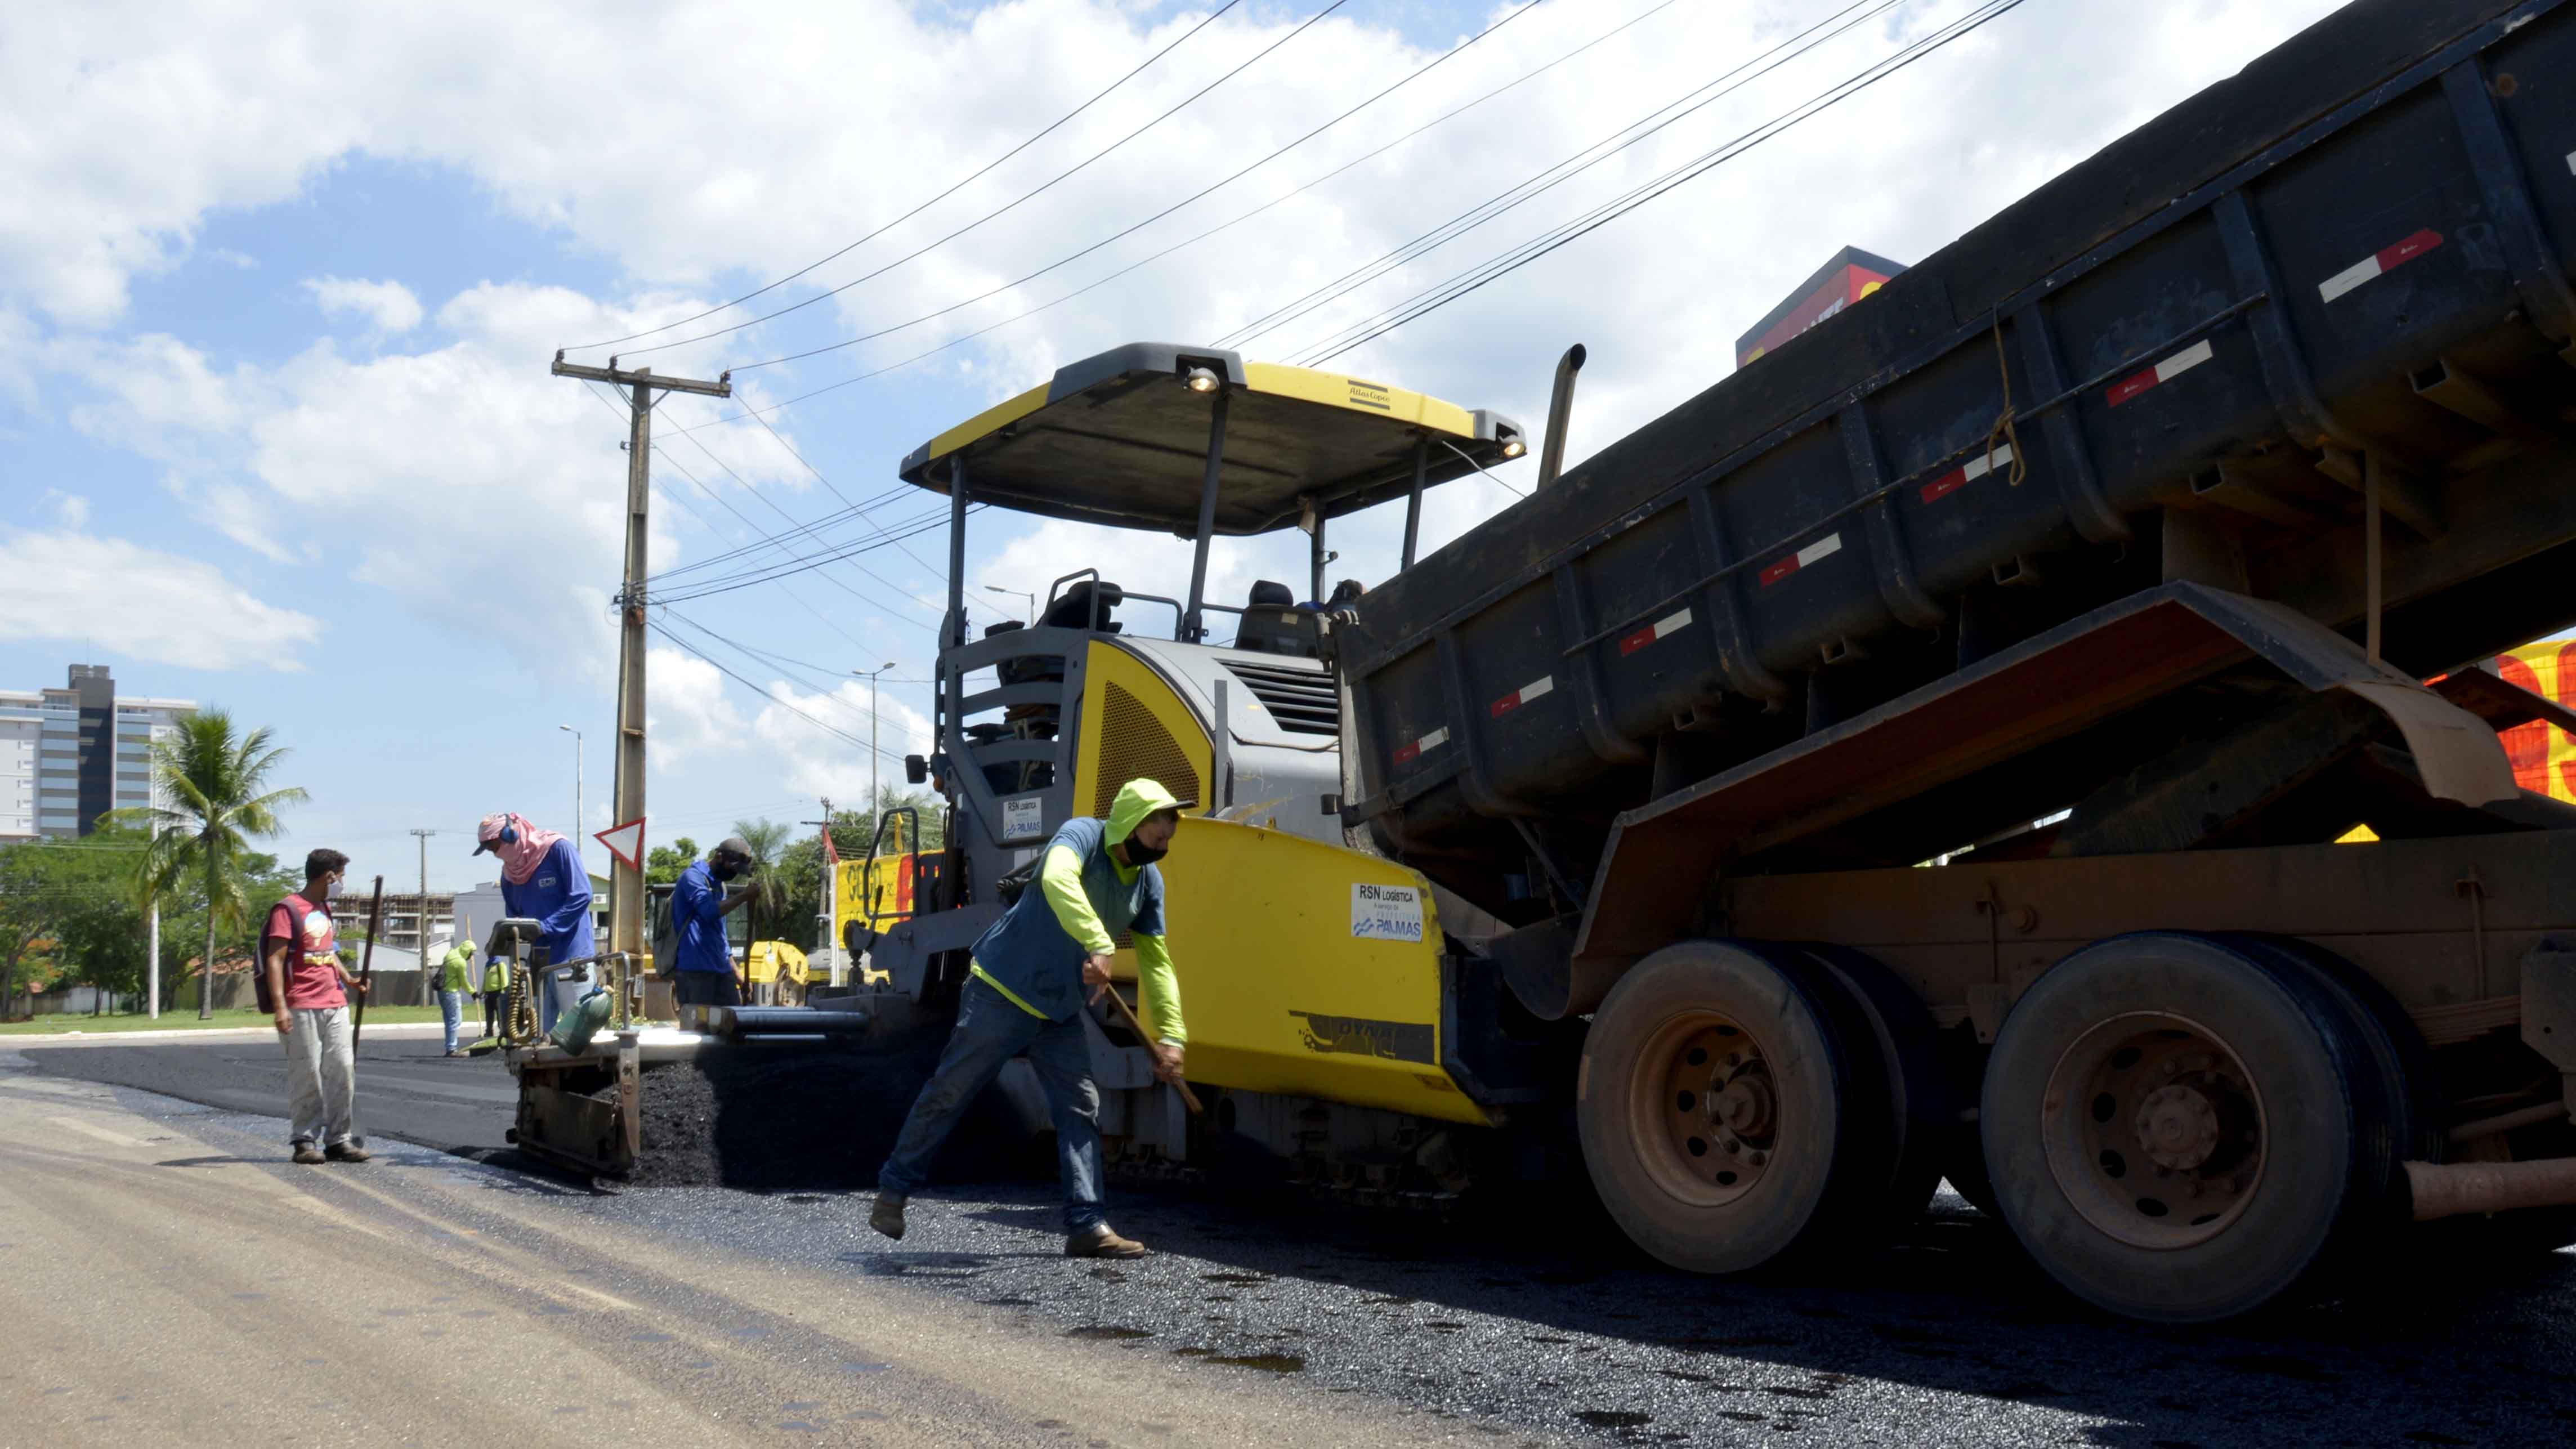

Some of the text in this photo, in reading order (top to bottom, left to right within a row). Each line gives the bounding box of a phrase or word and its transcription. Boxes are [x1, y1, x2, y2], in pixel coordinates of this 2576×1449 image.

[1018, 821, 1041, 832] PALMAS
[1359, 885, 1414, 902] RSN LOGÍSTICA
[1377, 919, 1420, 936] PALMAS
